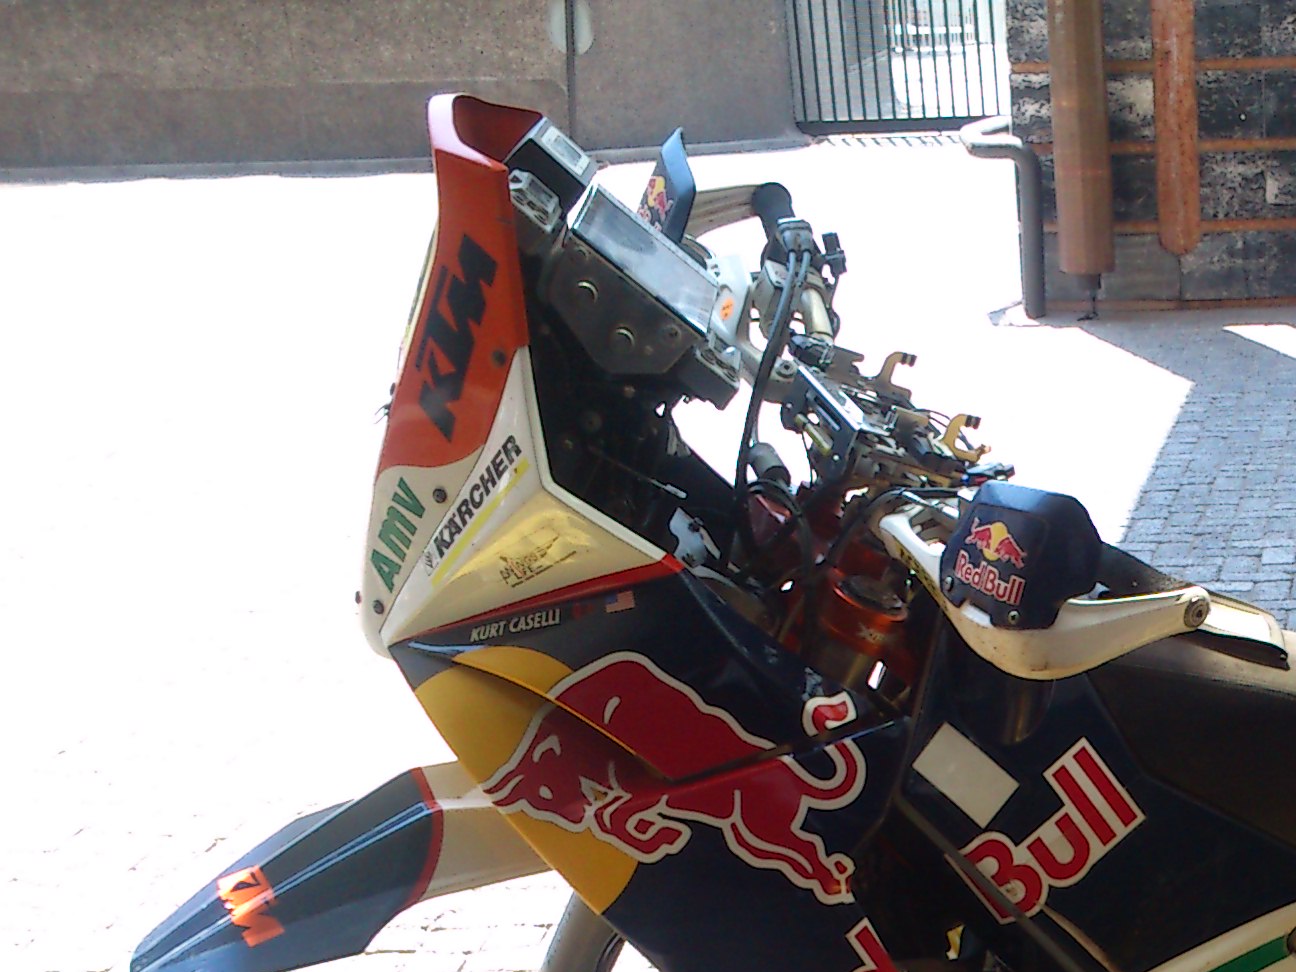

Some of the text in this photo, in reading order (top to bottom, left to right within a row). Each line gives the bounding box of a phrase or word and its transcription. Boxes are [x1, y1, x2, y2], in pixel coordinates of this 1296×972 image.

[415, 233, 498, 443] KTM
[469, 608, 561, 643] KURT CASELLI
[954, 549, 988, 590] Red
[983, 564, 1026, 606] Bull
[946, 736, 1147, 924] Bull
